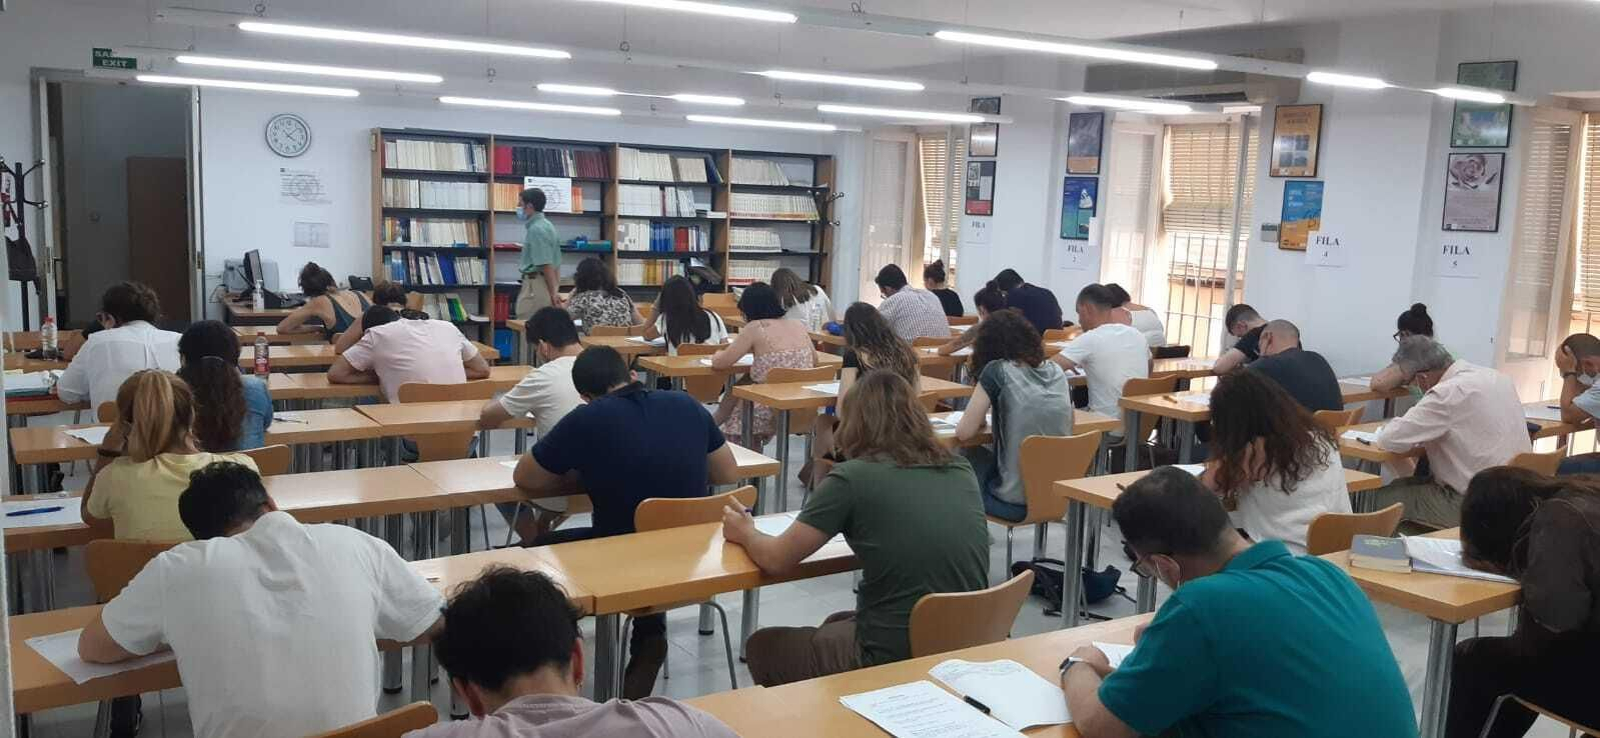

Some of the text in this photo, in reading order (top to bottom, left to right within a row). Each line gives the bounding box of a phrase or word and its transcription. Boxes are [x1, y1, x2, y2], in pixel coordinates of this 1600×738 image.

[102, 59, 128, 67] EXIT
[1316, 235, 1340, 246] FILA
[1067, 245, 1084, 254] FILA
[1443, 245, 1470, 255] FILA
